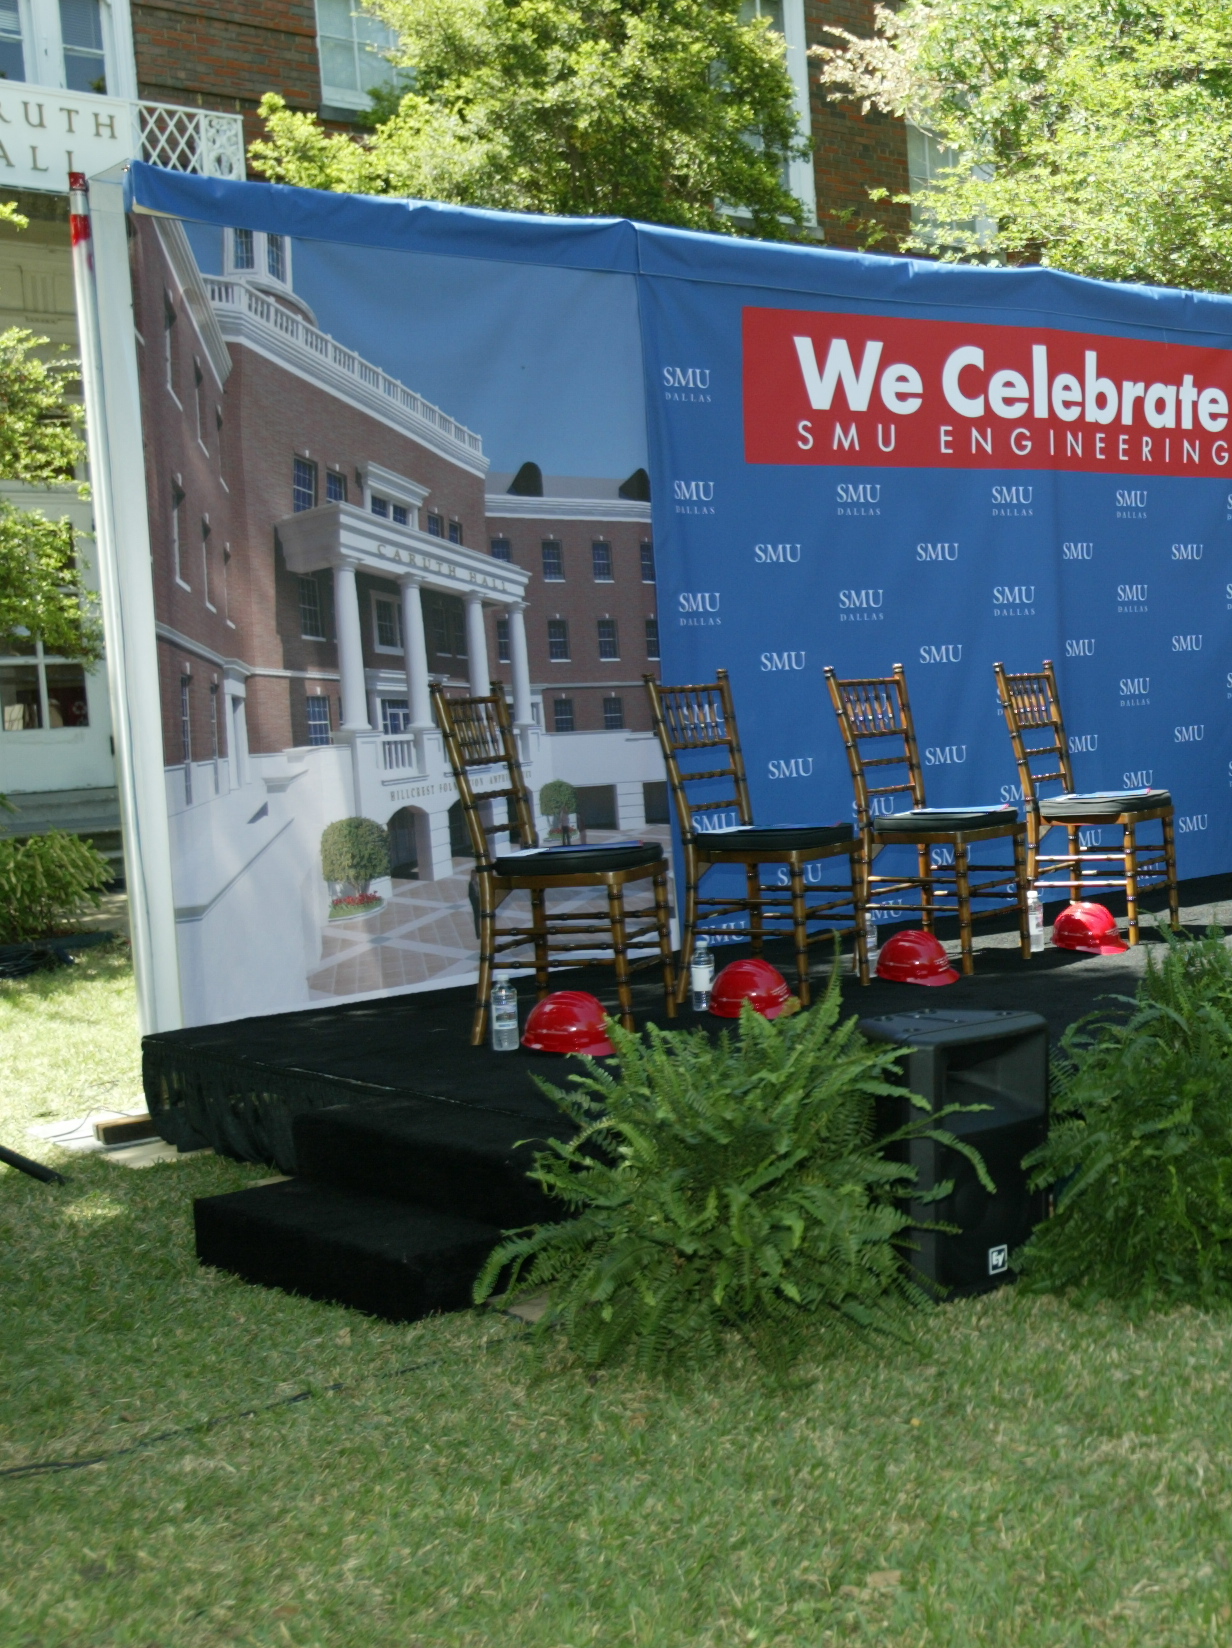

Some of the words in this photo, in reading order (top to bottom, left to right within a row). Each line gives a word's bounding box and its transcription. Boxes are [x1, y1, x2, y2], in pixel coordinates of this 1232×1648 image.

[663, 367, 710, 388] SMU
[793, 336, 923, 415] We
[942, 344, 1229, 433] Celebrate
[665, 392, 712, 402] DALLAS
[798, 420, 896, 452] SMU
[939, 425, 1229, 466] ENGINEERING
[674, 481, 714, 500] SMU
[836, 484, 881, 502] SMU
[991, 487, 1033, 503] SMU
[1116, 490, 1148, 507] SMU
[675, 506, 716, 514] DALLAS
[754, 544, 801, 562] SMU
[916, 544, 959, 561] SMU
[1062, 543, 1094, 559] SMU
[1171, 544, 1203, 559] SMU
[377, 544, 457, 577] CARUTH
[839, 590, 884, 608] SMU
[993, 586, 1035, 604] SMU
[1117, 585, 1148, 601] SMU
[678, 593, 720, 612] SMU
[839, 613, 884, 621] DALLAS
[993, 608, 1036, 616] DALLAS
[1065, 639, 1096, 656] SMU
[1171, 635, 1203, 651] SMU
[760, 652, 806, 671] SMU
[919, 645, 963, 663] SMU
[1119, 678, 1150, 695] SMU
[1174, 725, 1205, 742] SMU
[1068, 735, 1098, 753] SMU
[925, 745, 966, 765] SMU
[768, 758, 814, 779] SMU
[1122, 770, 1154, 788] SMU
[1178, 814, 1208, 833] SMU
[1079, 829, 1102, 847] MU
[777, 863, 822, 887] SU
